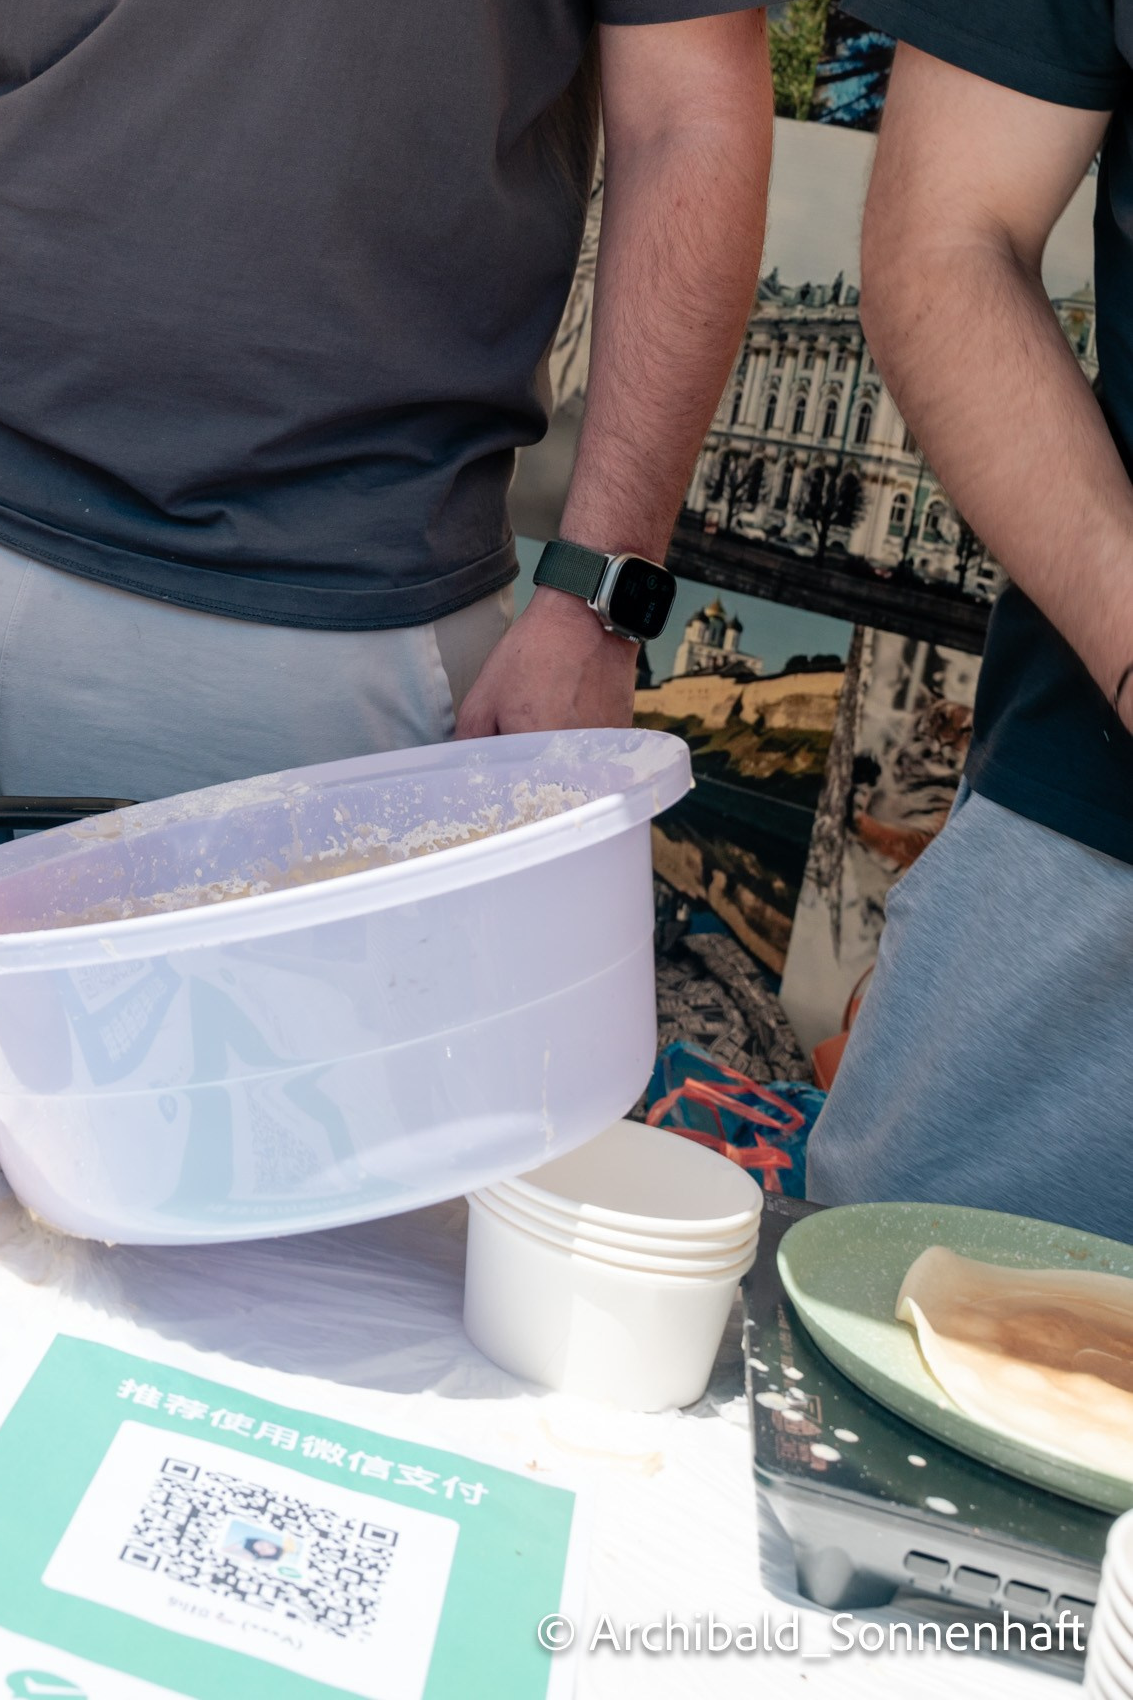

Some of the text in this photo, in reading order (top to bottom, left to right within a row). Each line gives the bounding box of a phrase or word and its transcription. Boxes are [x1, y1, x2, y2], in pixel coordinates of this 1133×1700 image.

[116, 1378, 490, 1506] 推荐使用微信支付
